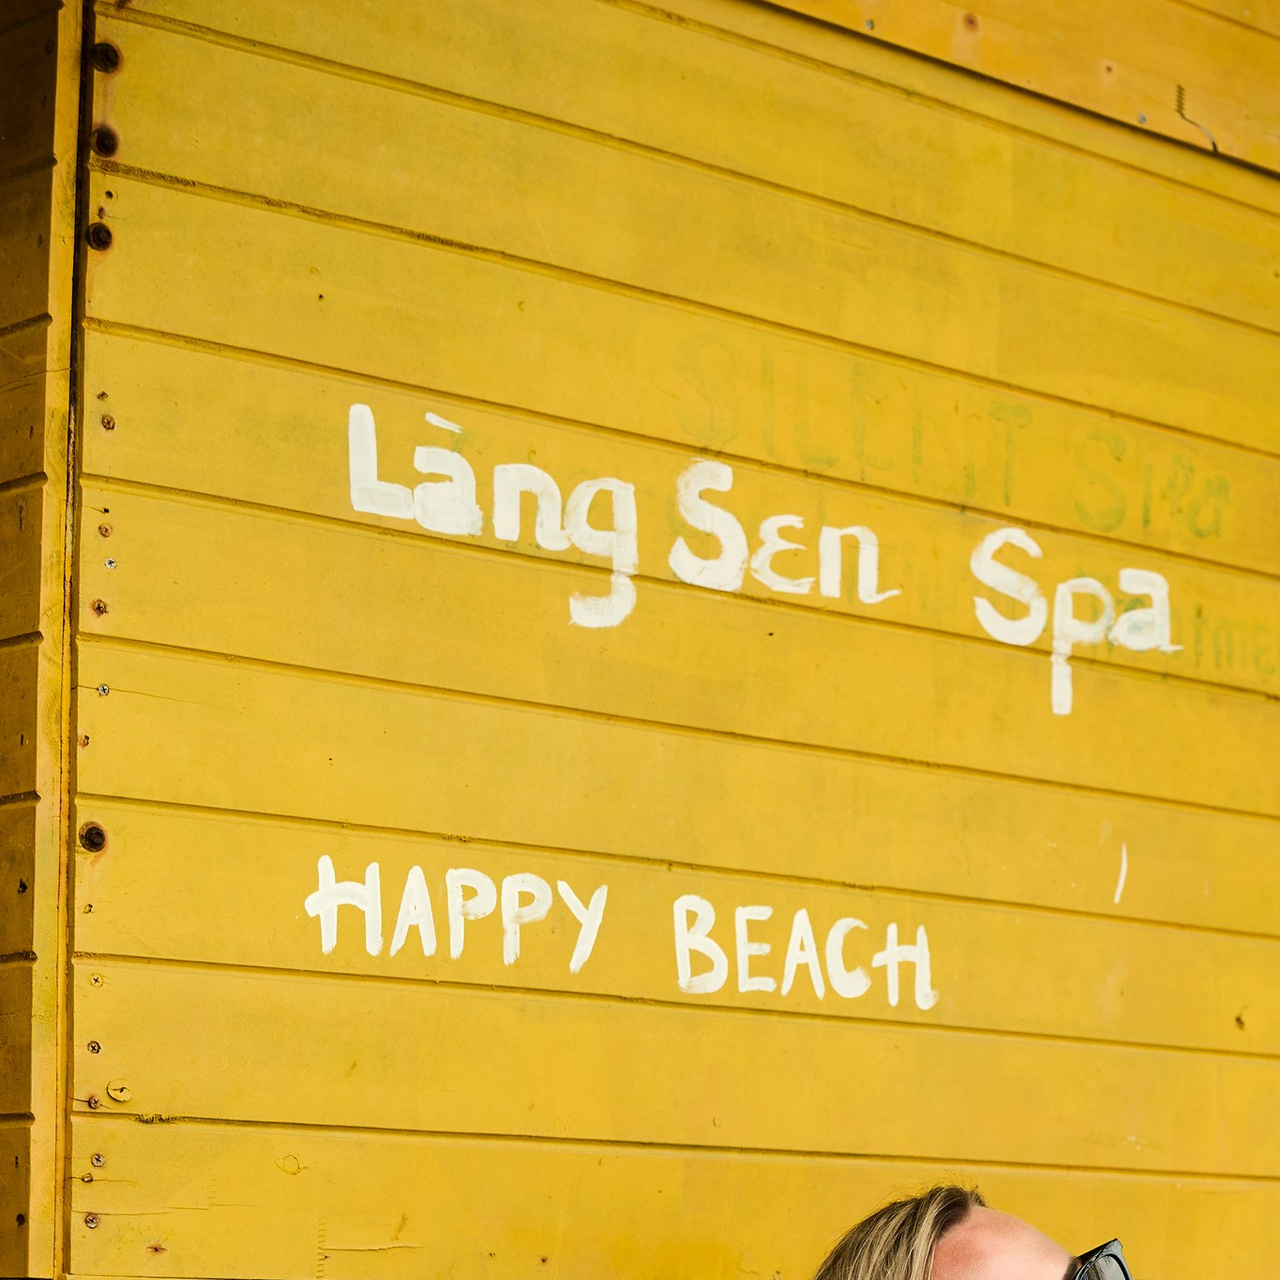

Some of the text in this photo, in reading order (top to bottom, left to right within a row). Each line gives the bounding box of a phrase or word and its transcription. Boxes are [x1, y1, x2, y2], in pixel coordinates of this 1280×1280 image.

[666, 457, 901, 605] Sen
[969, 526, 1183, 716] Spa
[304, 854, 939, 1011] HAPPY BEACH
